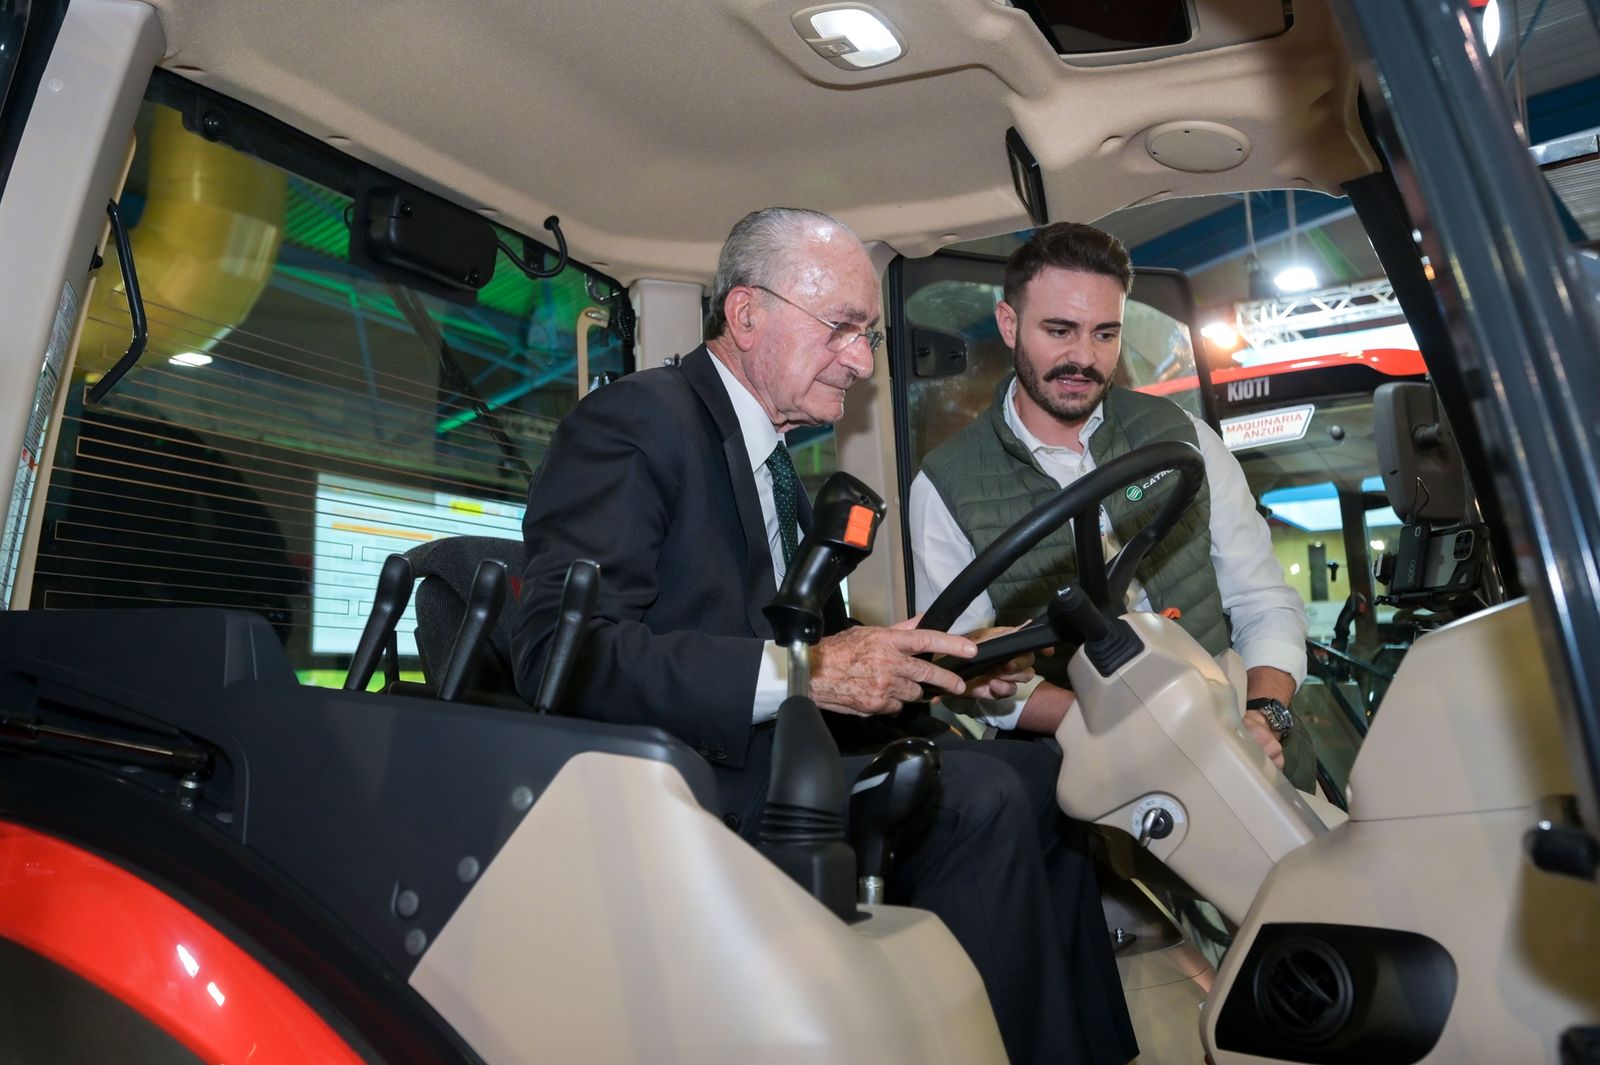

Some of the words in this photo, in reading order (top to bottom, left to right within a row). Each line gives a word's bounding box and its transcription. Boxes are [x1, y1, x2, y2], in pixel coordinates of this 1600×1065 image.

[1227, 376, 1270, 402] KIOTI
[1226, 413, 1303, 433] MAQUINARIA
[1243, 425, 1285, 440] ANZUR
